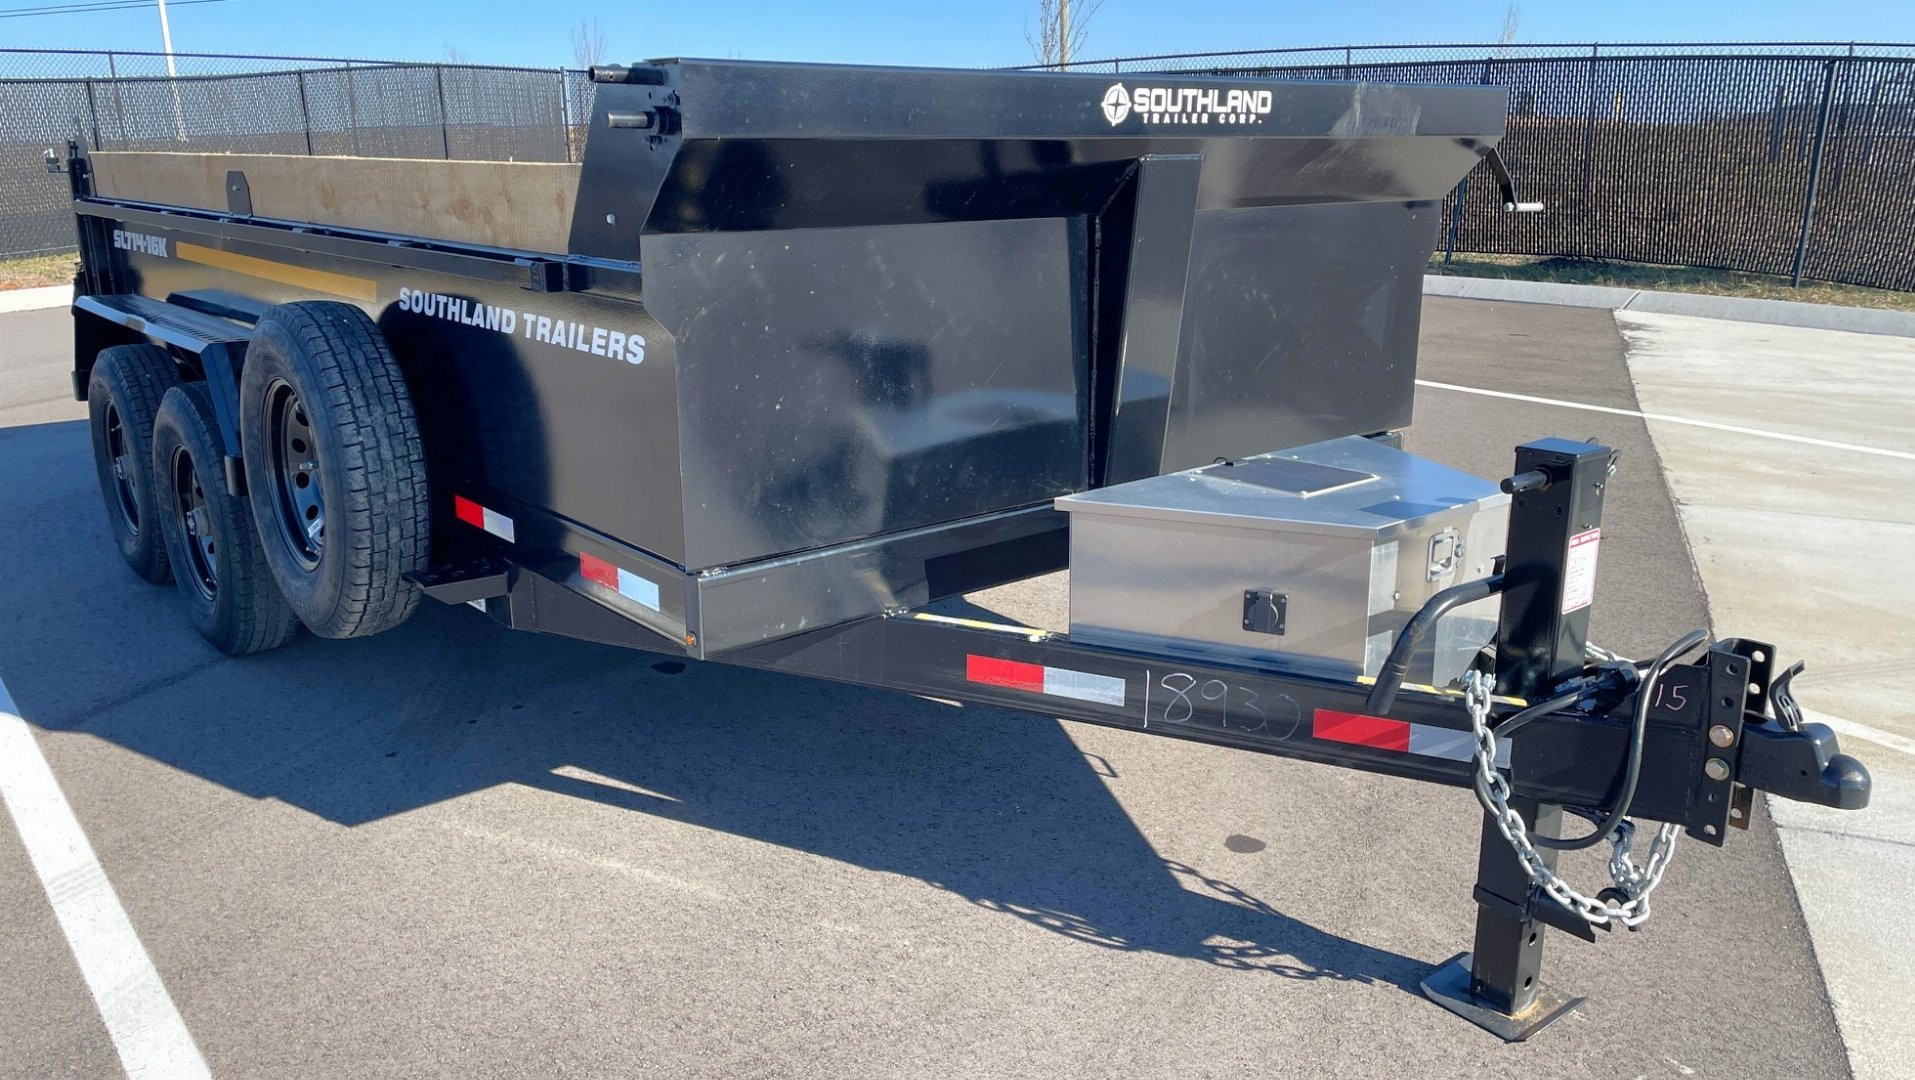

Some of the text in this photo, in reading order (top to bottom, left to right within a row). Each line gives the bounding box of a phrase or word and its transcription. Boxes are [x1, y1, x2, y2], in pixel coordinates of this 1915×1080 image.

[1133, 88, 1272, 113] SOUTHLAND
[1143, 113, 1263, 124] TRAILER CORP.
[113, 229, 168, 258] SL714-16K
[399, 287, 646, 364] SOUTHLAND TRAILERS
[1655, 683, 1689, 711] 15
